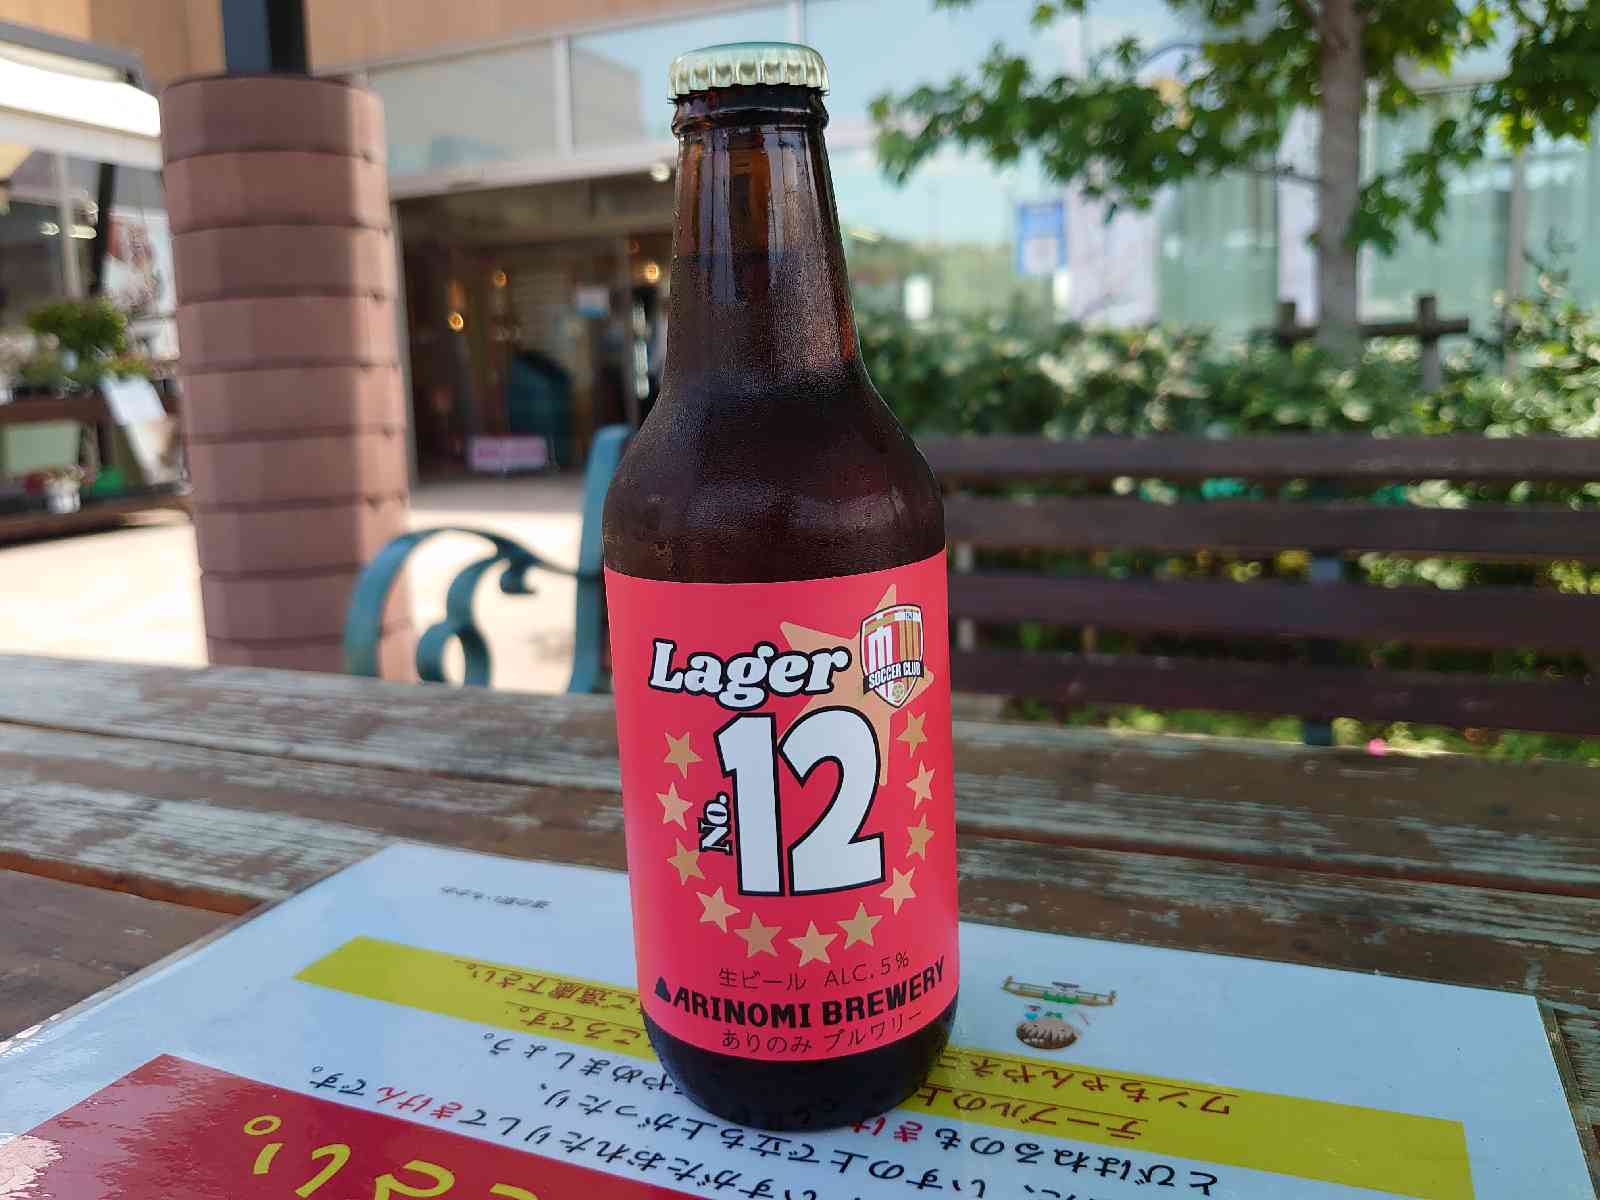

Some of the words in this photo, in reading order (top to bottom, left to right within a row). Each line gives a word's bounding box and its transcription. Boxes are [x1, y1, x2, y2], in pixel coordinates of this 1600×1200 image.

[648, 638, 851, 711] Lager
[868, 663, 902, 688] SOCCER
[902, 661, 921, 677] CLUB
[697, 791, 733, 856] No.
[713, 705, 886, 897] 12
[465, 962, 642, 1016] ご遠慮下さい。
[672, 986, 811, 1030] ARINOMI
[822, 955, 945, 1027] BREWERY
[718, 967, 807, 992] 生ビール
[518, 1006, 651, 1048] ころです。
[722, 1029, 812, 1055] ありのみ
[824, 1010, 922, 1053] ブルワリー
[482, 1031, 683, 1096] やめましょう。
